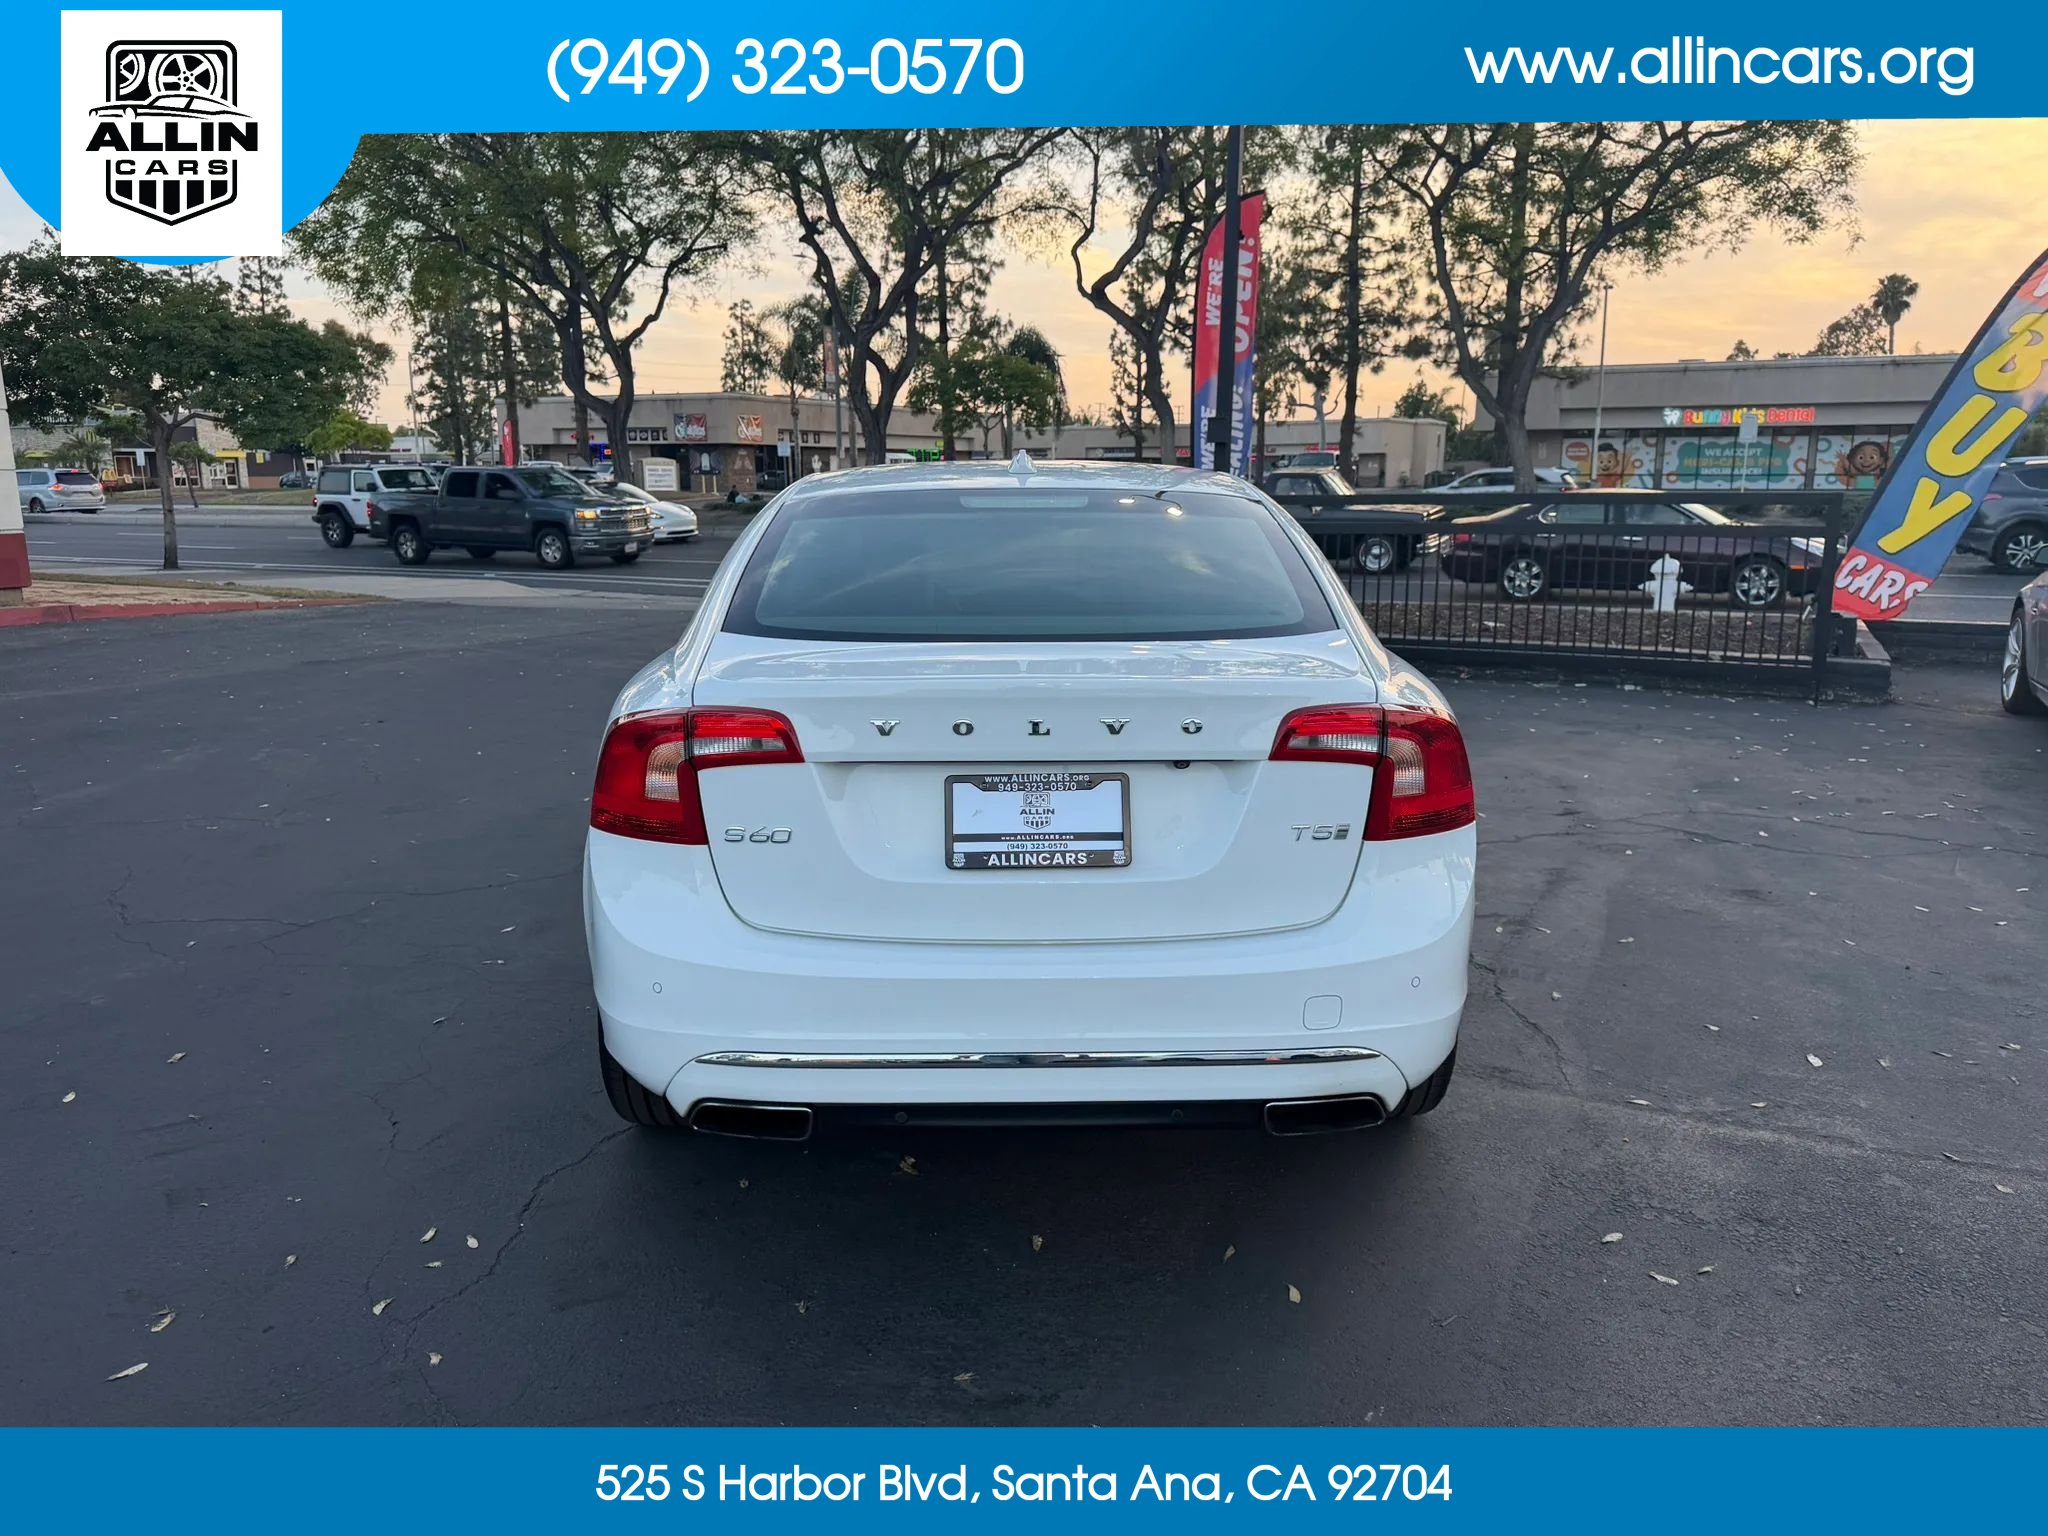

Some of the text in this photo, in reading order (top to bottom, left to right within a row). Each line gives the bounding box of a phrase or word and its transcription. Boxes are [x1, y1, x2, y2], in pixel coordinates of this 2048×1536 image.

[1205, 257, 1224, 326] WE'RE
[1684, 407, 1814, 425] Bunny Ks Dental
[1704, 448, 1722, 456] WE
[870, 717, 1203, 737] VOLVO
[998, 782, 1077, 792] 949-323-0570
[724, 826, 792, 843] S60
[1030, 842, 1068, 850] 323-0570
[987, 852, 1088, 866] ALLINCARS
